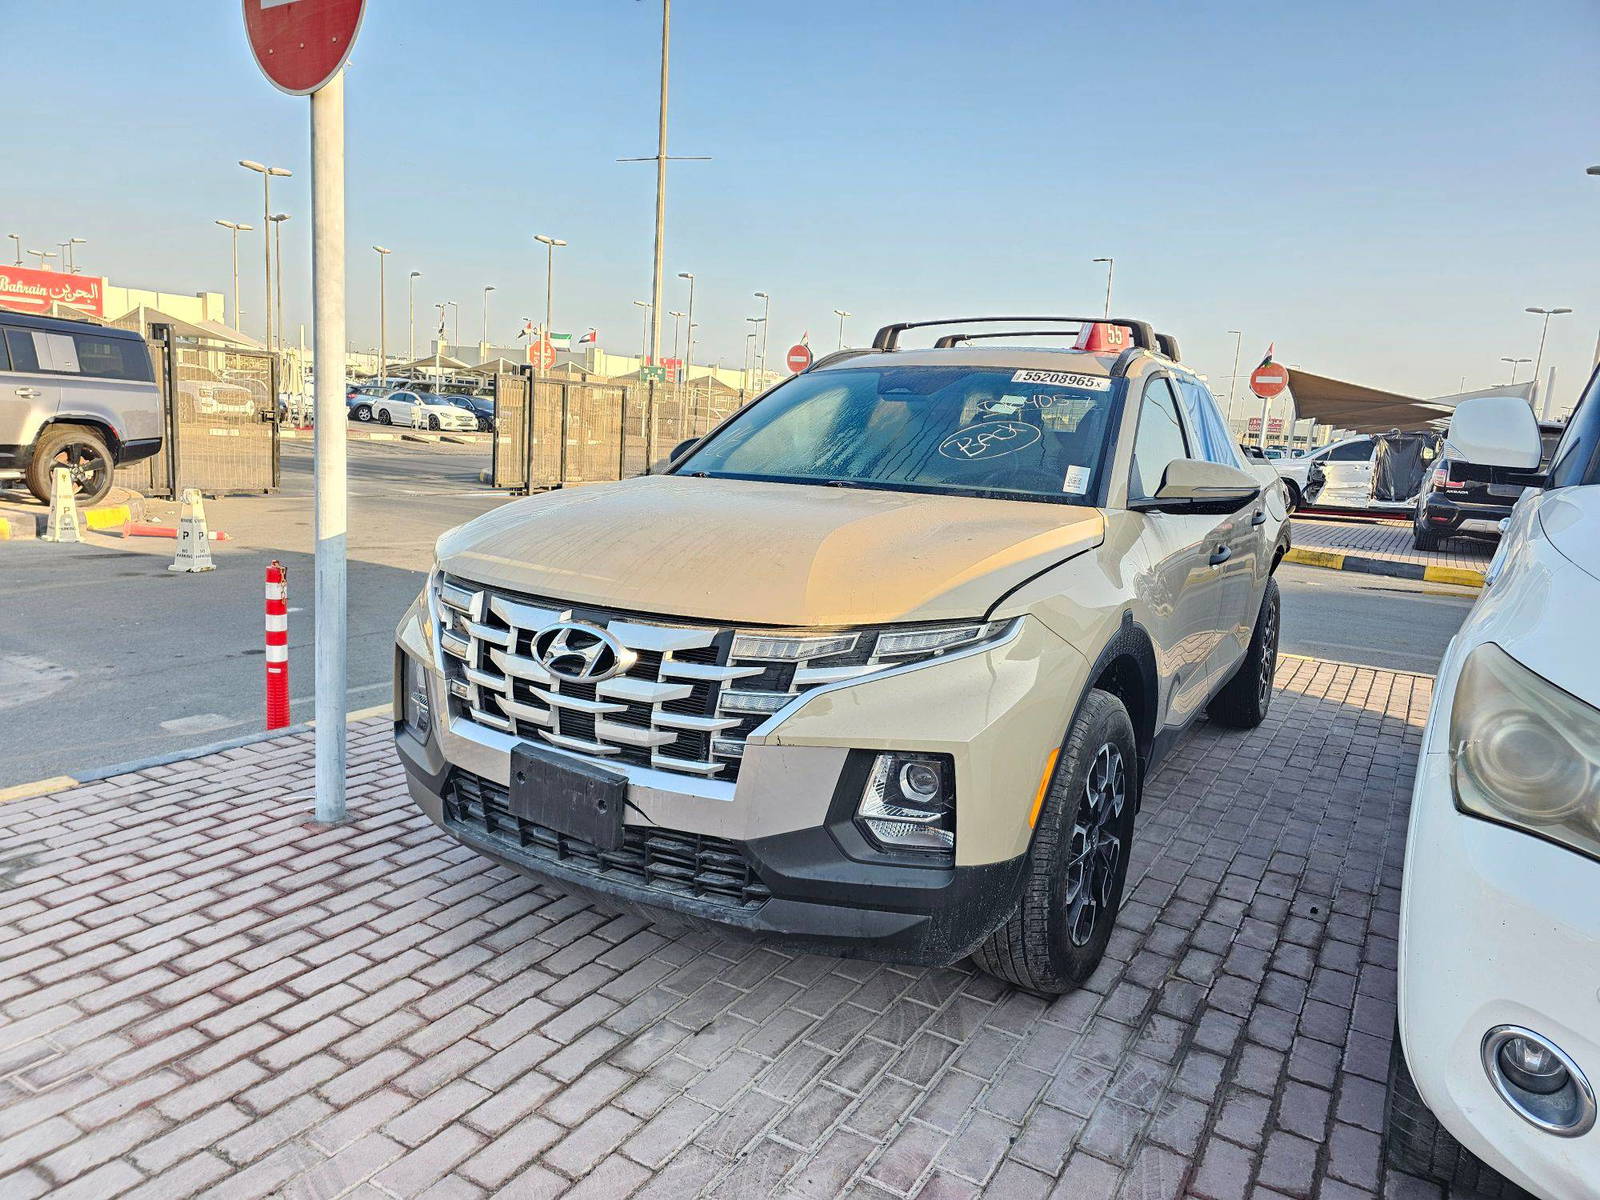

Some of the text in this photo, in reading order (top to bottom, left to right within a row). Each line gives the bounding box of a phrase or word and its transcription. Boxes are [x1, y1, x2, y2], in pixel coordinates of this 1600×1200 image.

[0, 275, 47, 296] Bahrain
[49, 282, 98, 304] البحرين
[1107, 324, 1123, 345] 55
[533, 358, 551, 367] SOP
[1023, 371, 1095, 387] 55208965
[183, 531, 190, 540] P
[198, 531, 204, 540] P
